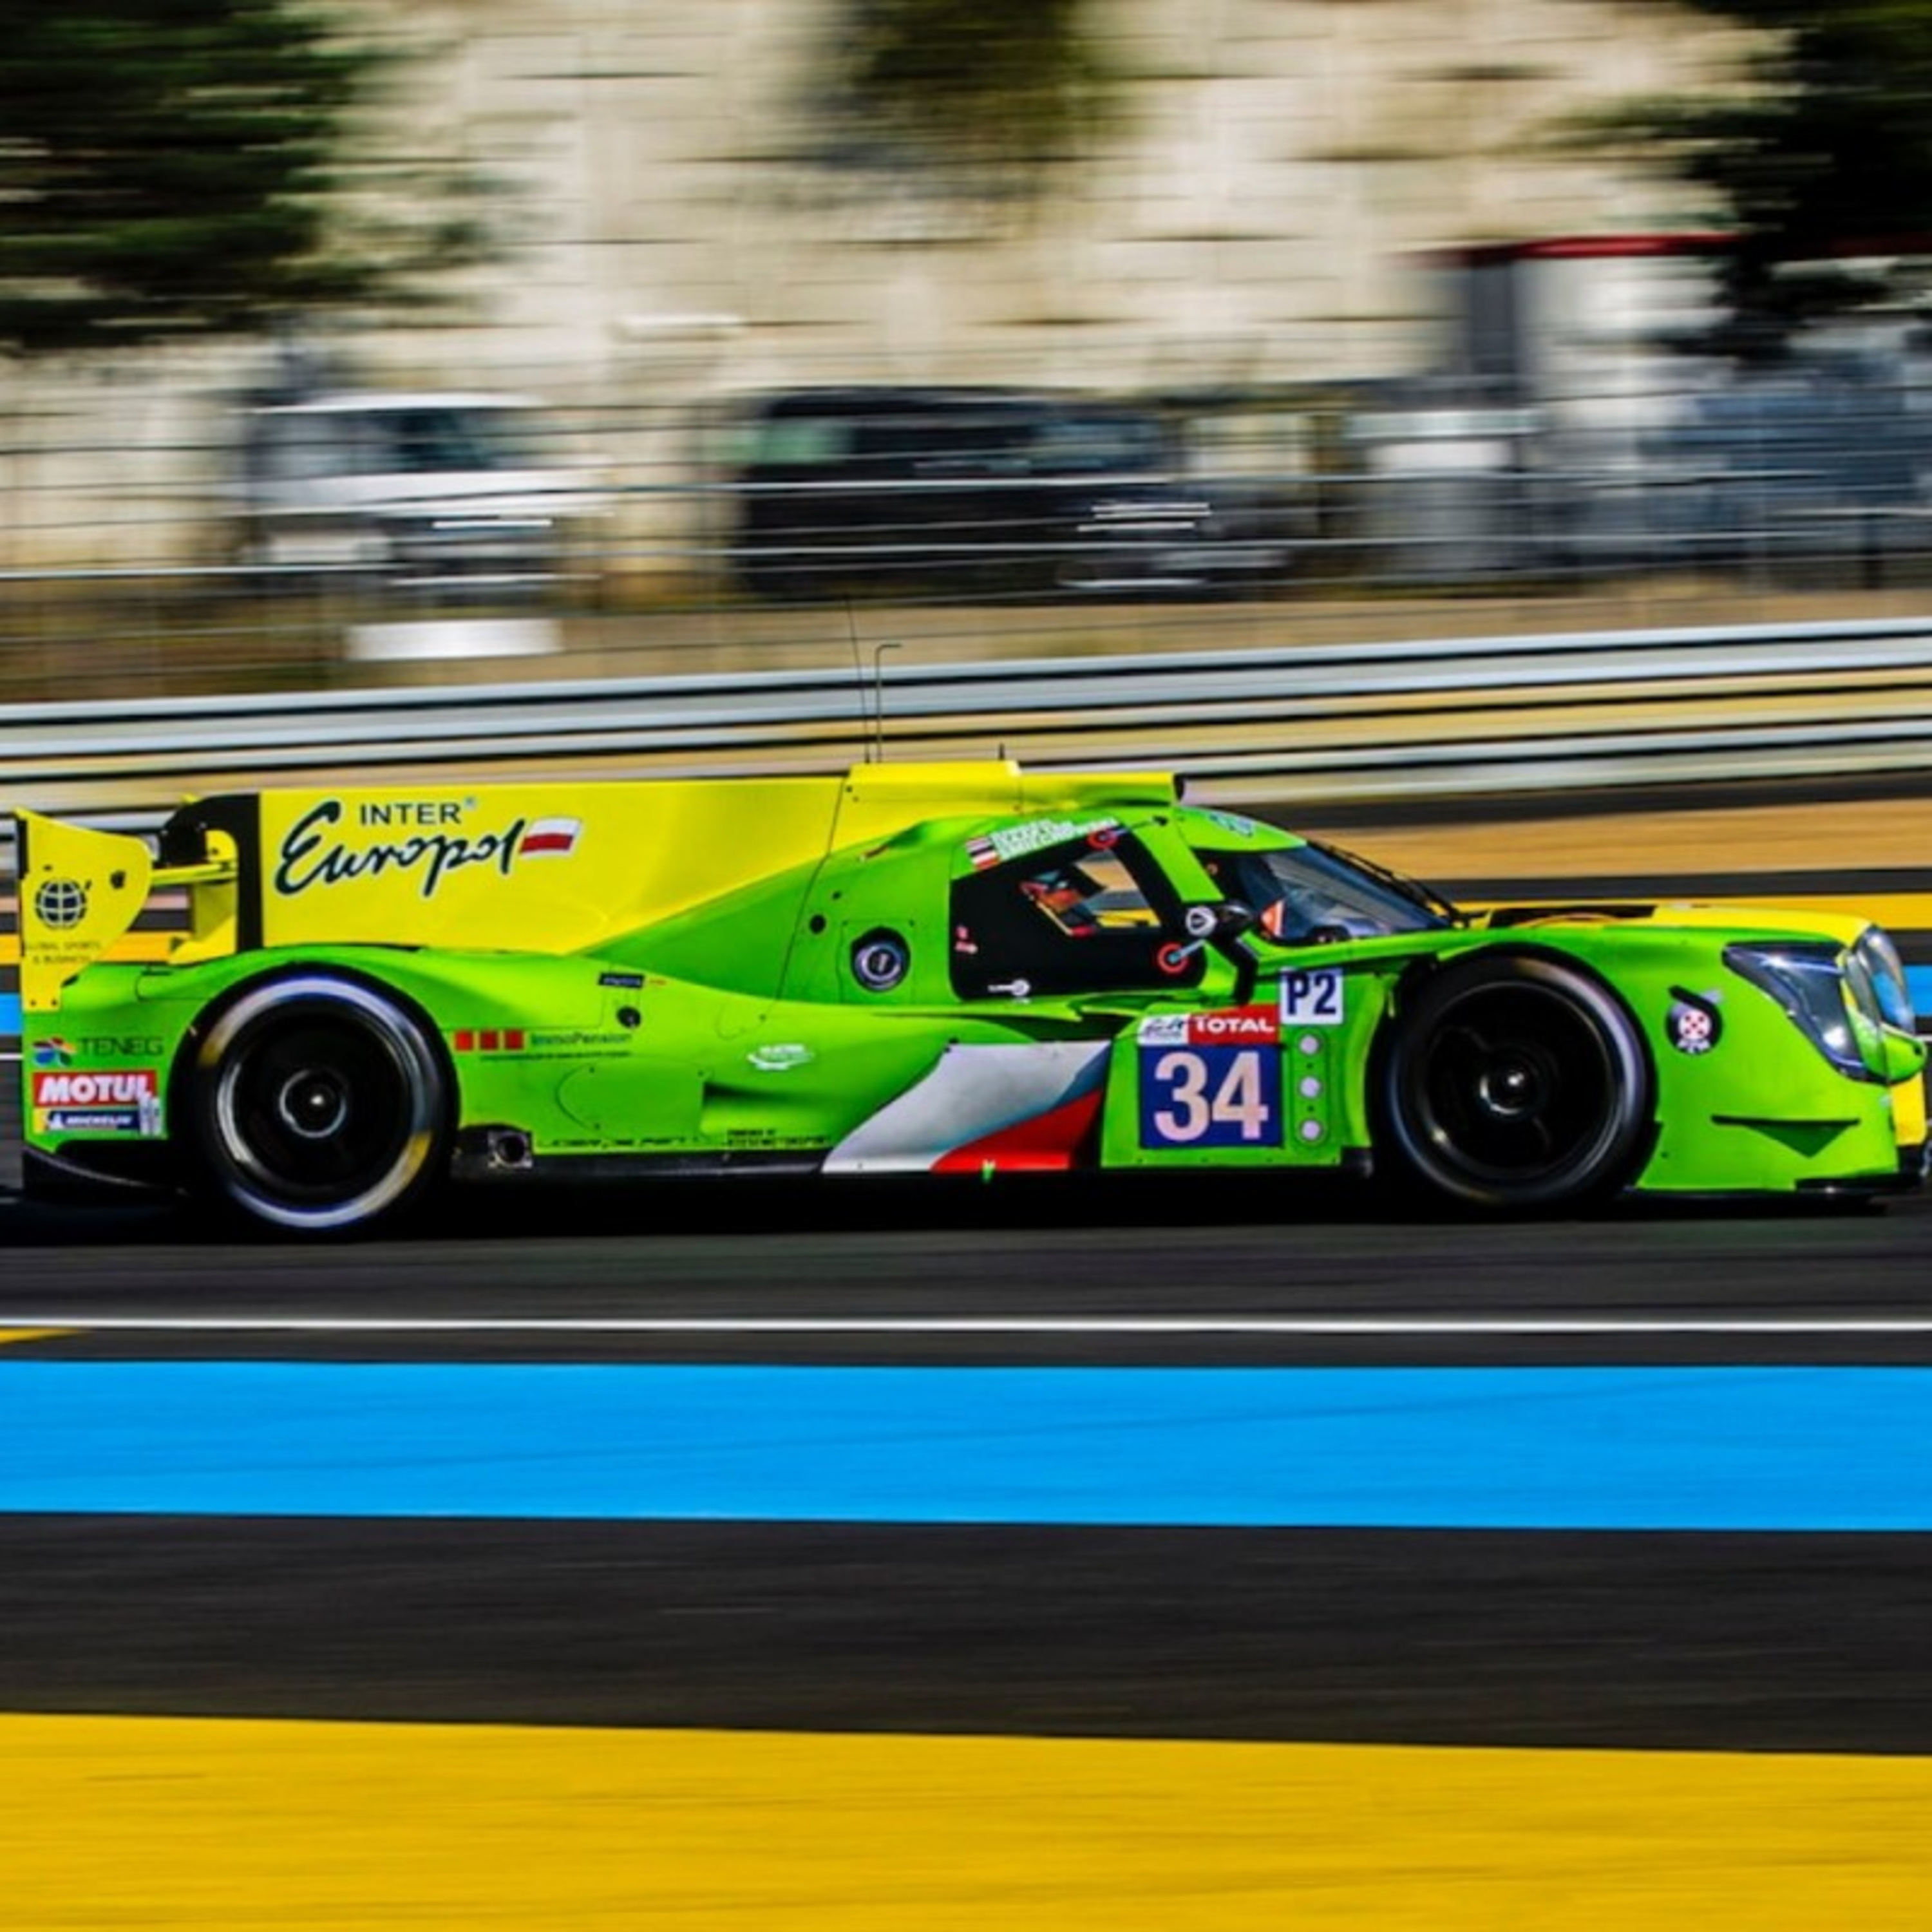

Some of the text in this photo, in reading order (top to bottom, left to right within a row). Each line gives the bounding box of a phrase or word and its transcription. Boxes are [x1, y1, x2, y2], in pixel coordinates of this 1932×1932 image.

[360, 802, 462, 825] INTER
[274, 800, 526, 897] Europol
[1286, 972, 1338, 1016] P2
[1194, 1016, 1276, 1034] TOTAL
[78, 1037, 164, 1056] TENEG
[38, 1074, 153, 1104] MOTUL
[1153, 1051, 1269, 1142] 34
